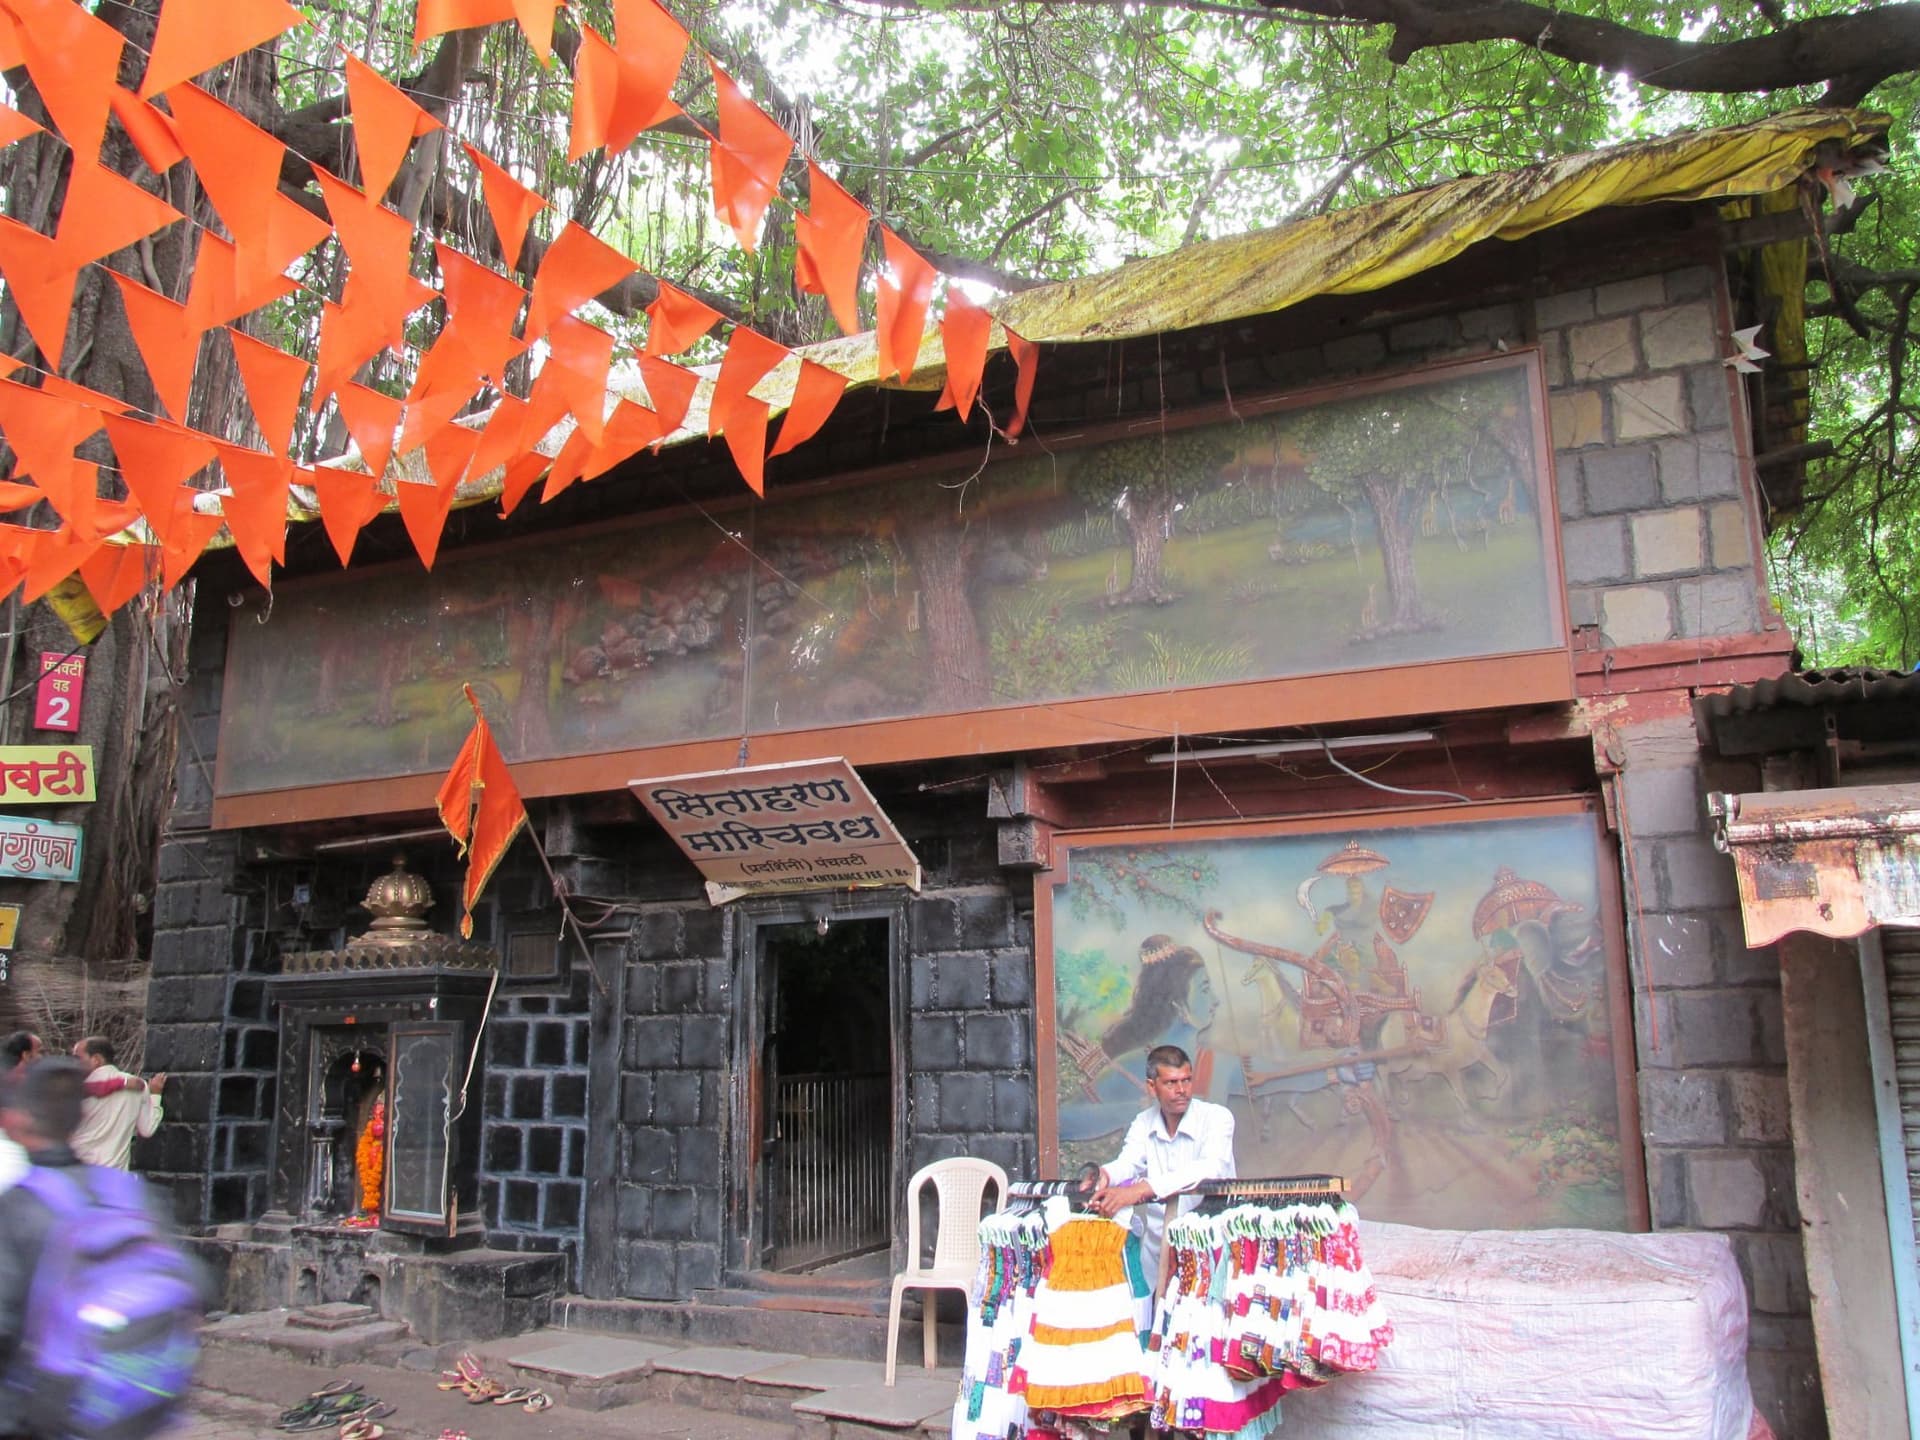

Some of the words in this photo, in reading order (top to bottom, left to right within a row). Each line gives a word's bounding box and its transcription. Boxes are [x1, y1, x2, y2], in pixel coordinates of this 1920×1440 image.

[53, 679, 71, 692] वड
[46, 696, 70, 726] 2
[651, 779, 851, 820] सिताहरण
[681, 816, 880, 851] मारिचवध
[815, 853, 867, 868] पंचवटी
[814, 872, 865, 882] ENTRANCE
